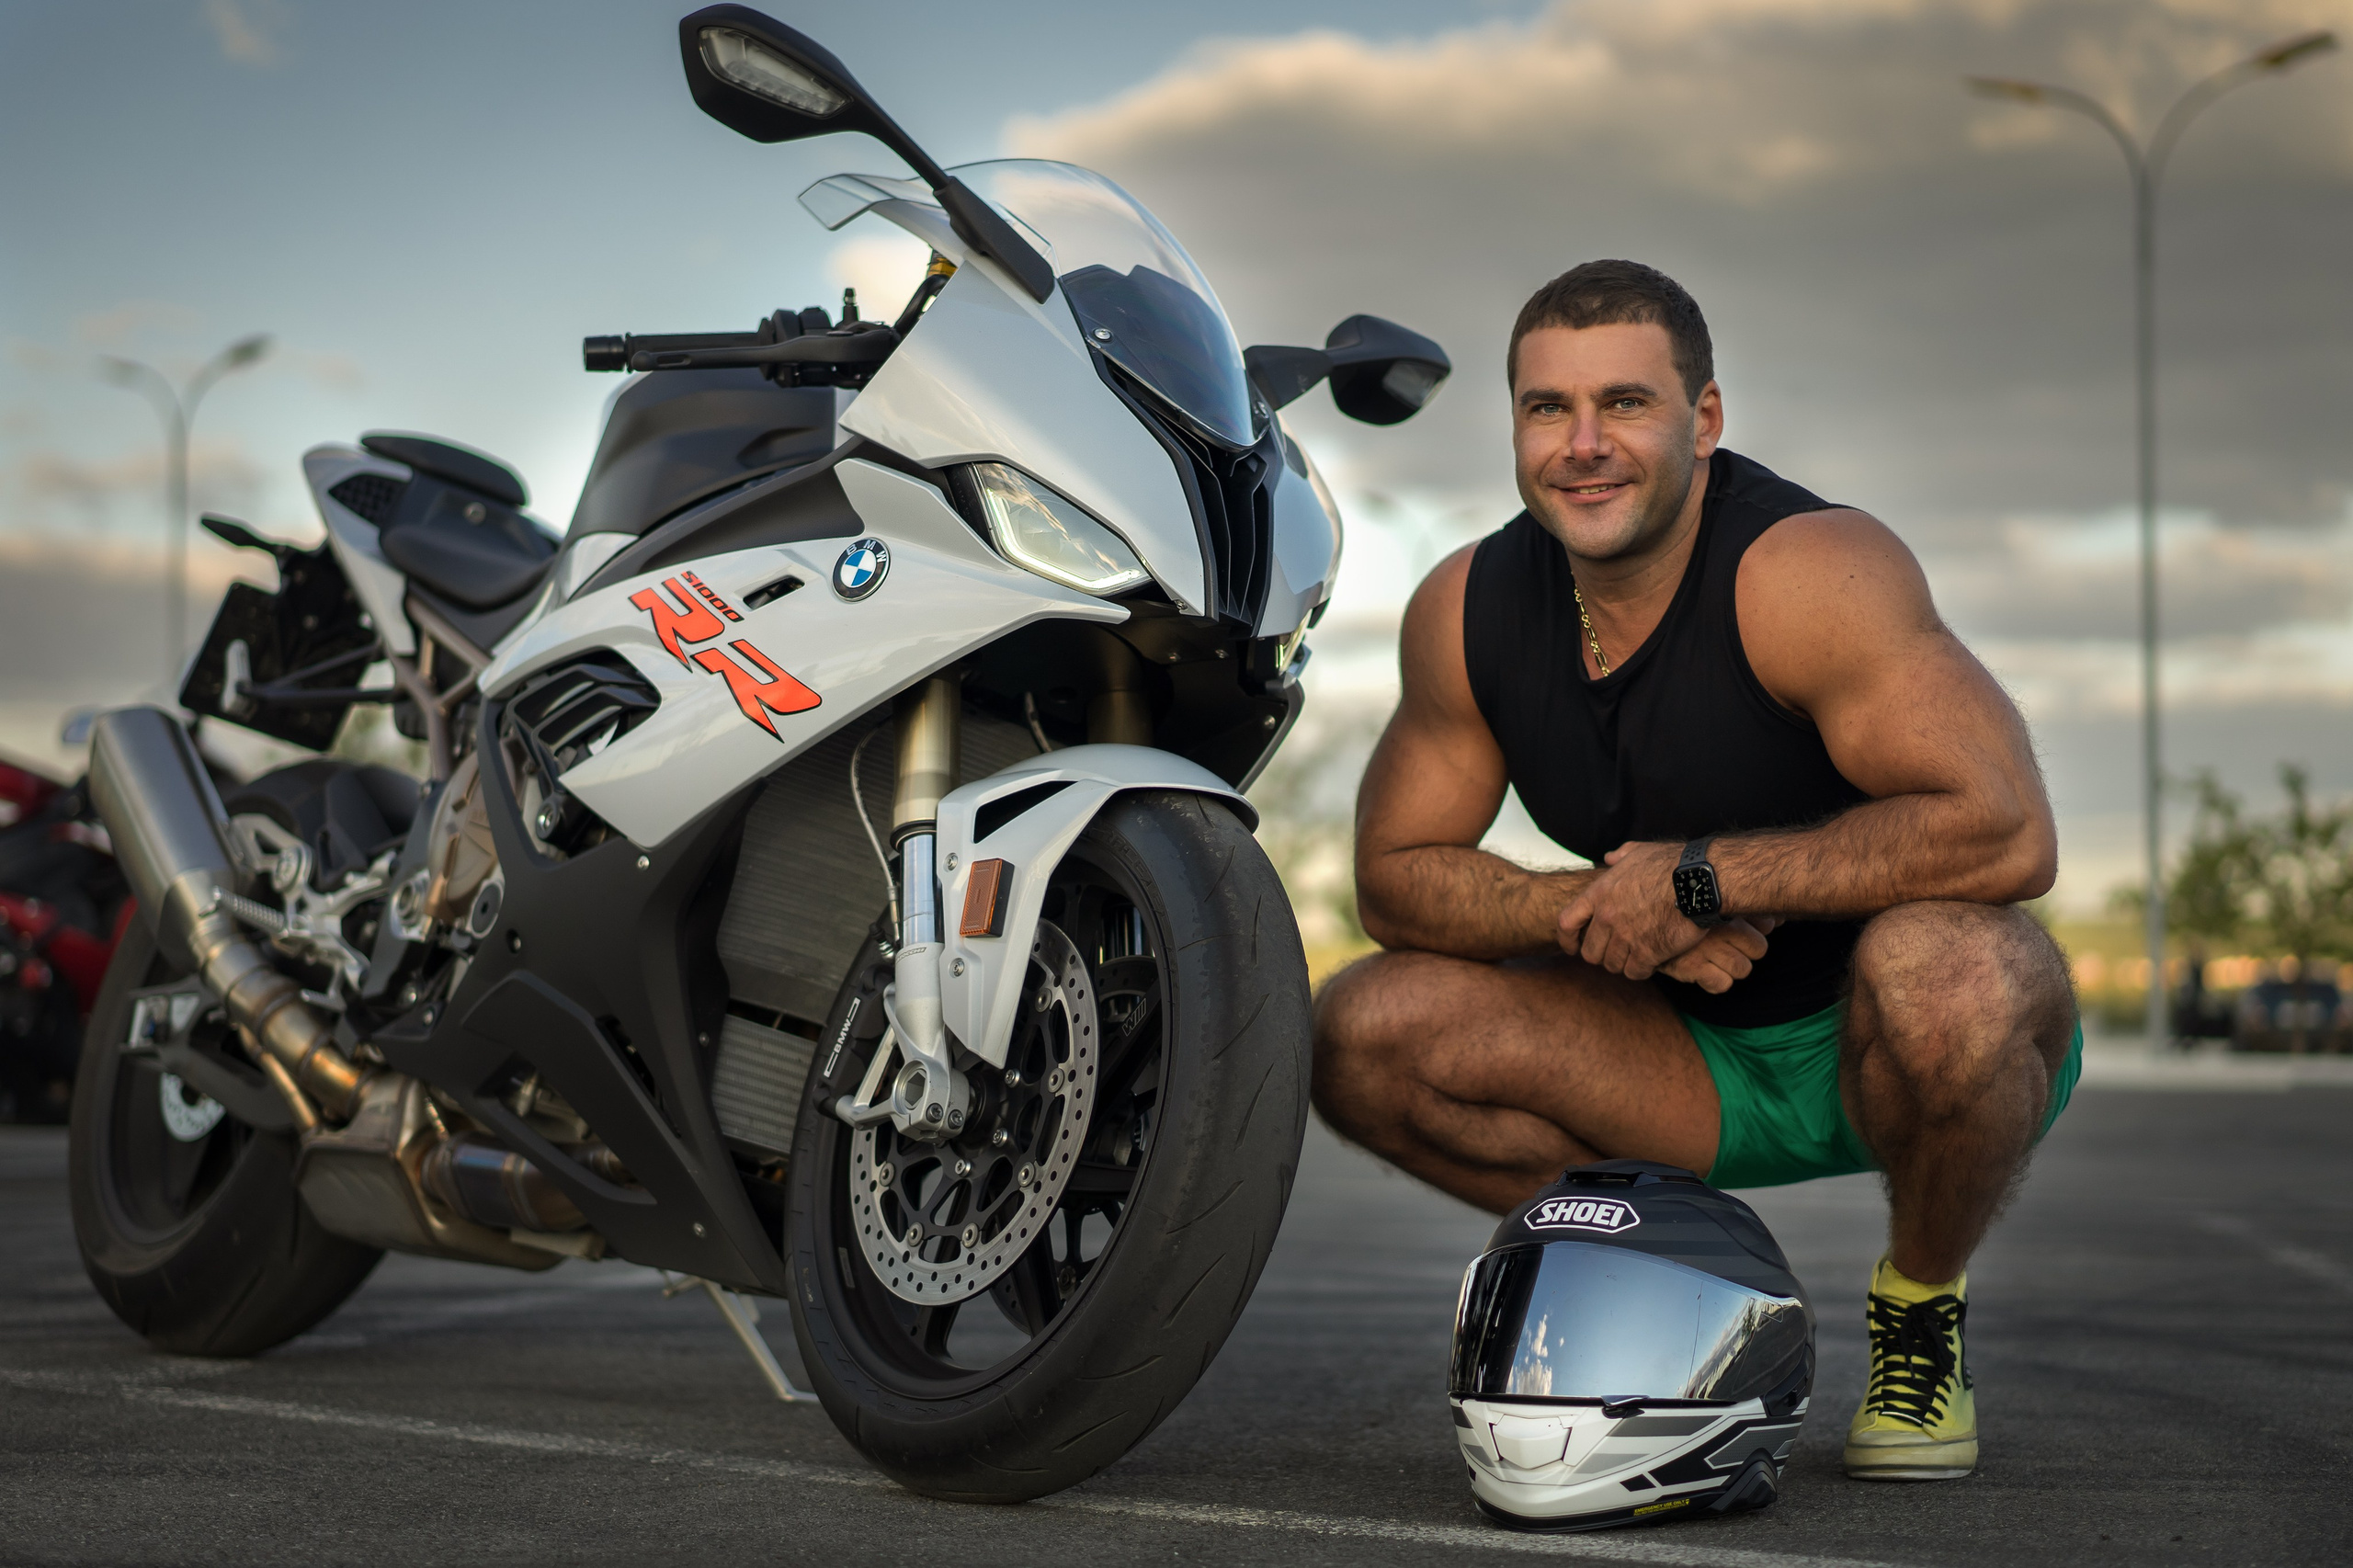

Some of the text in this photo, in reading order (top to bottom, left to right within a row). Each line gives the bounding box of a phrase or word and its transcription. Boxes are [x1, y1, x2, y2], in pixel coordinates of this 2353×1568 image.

[846, 539, 887, 563] BMW
[680, 570, 745, 623] S1000
[628, 577, 823, 744] RR
[833, 1018, 852, 1053] BMW
[1536, 1201, 1625, 1227] SHOEI
